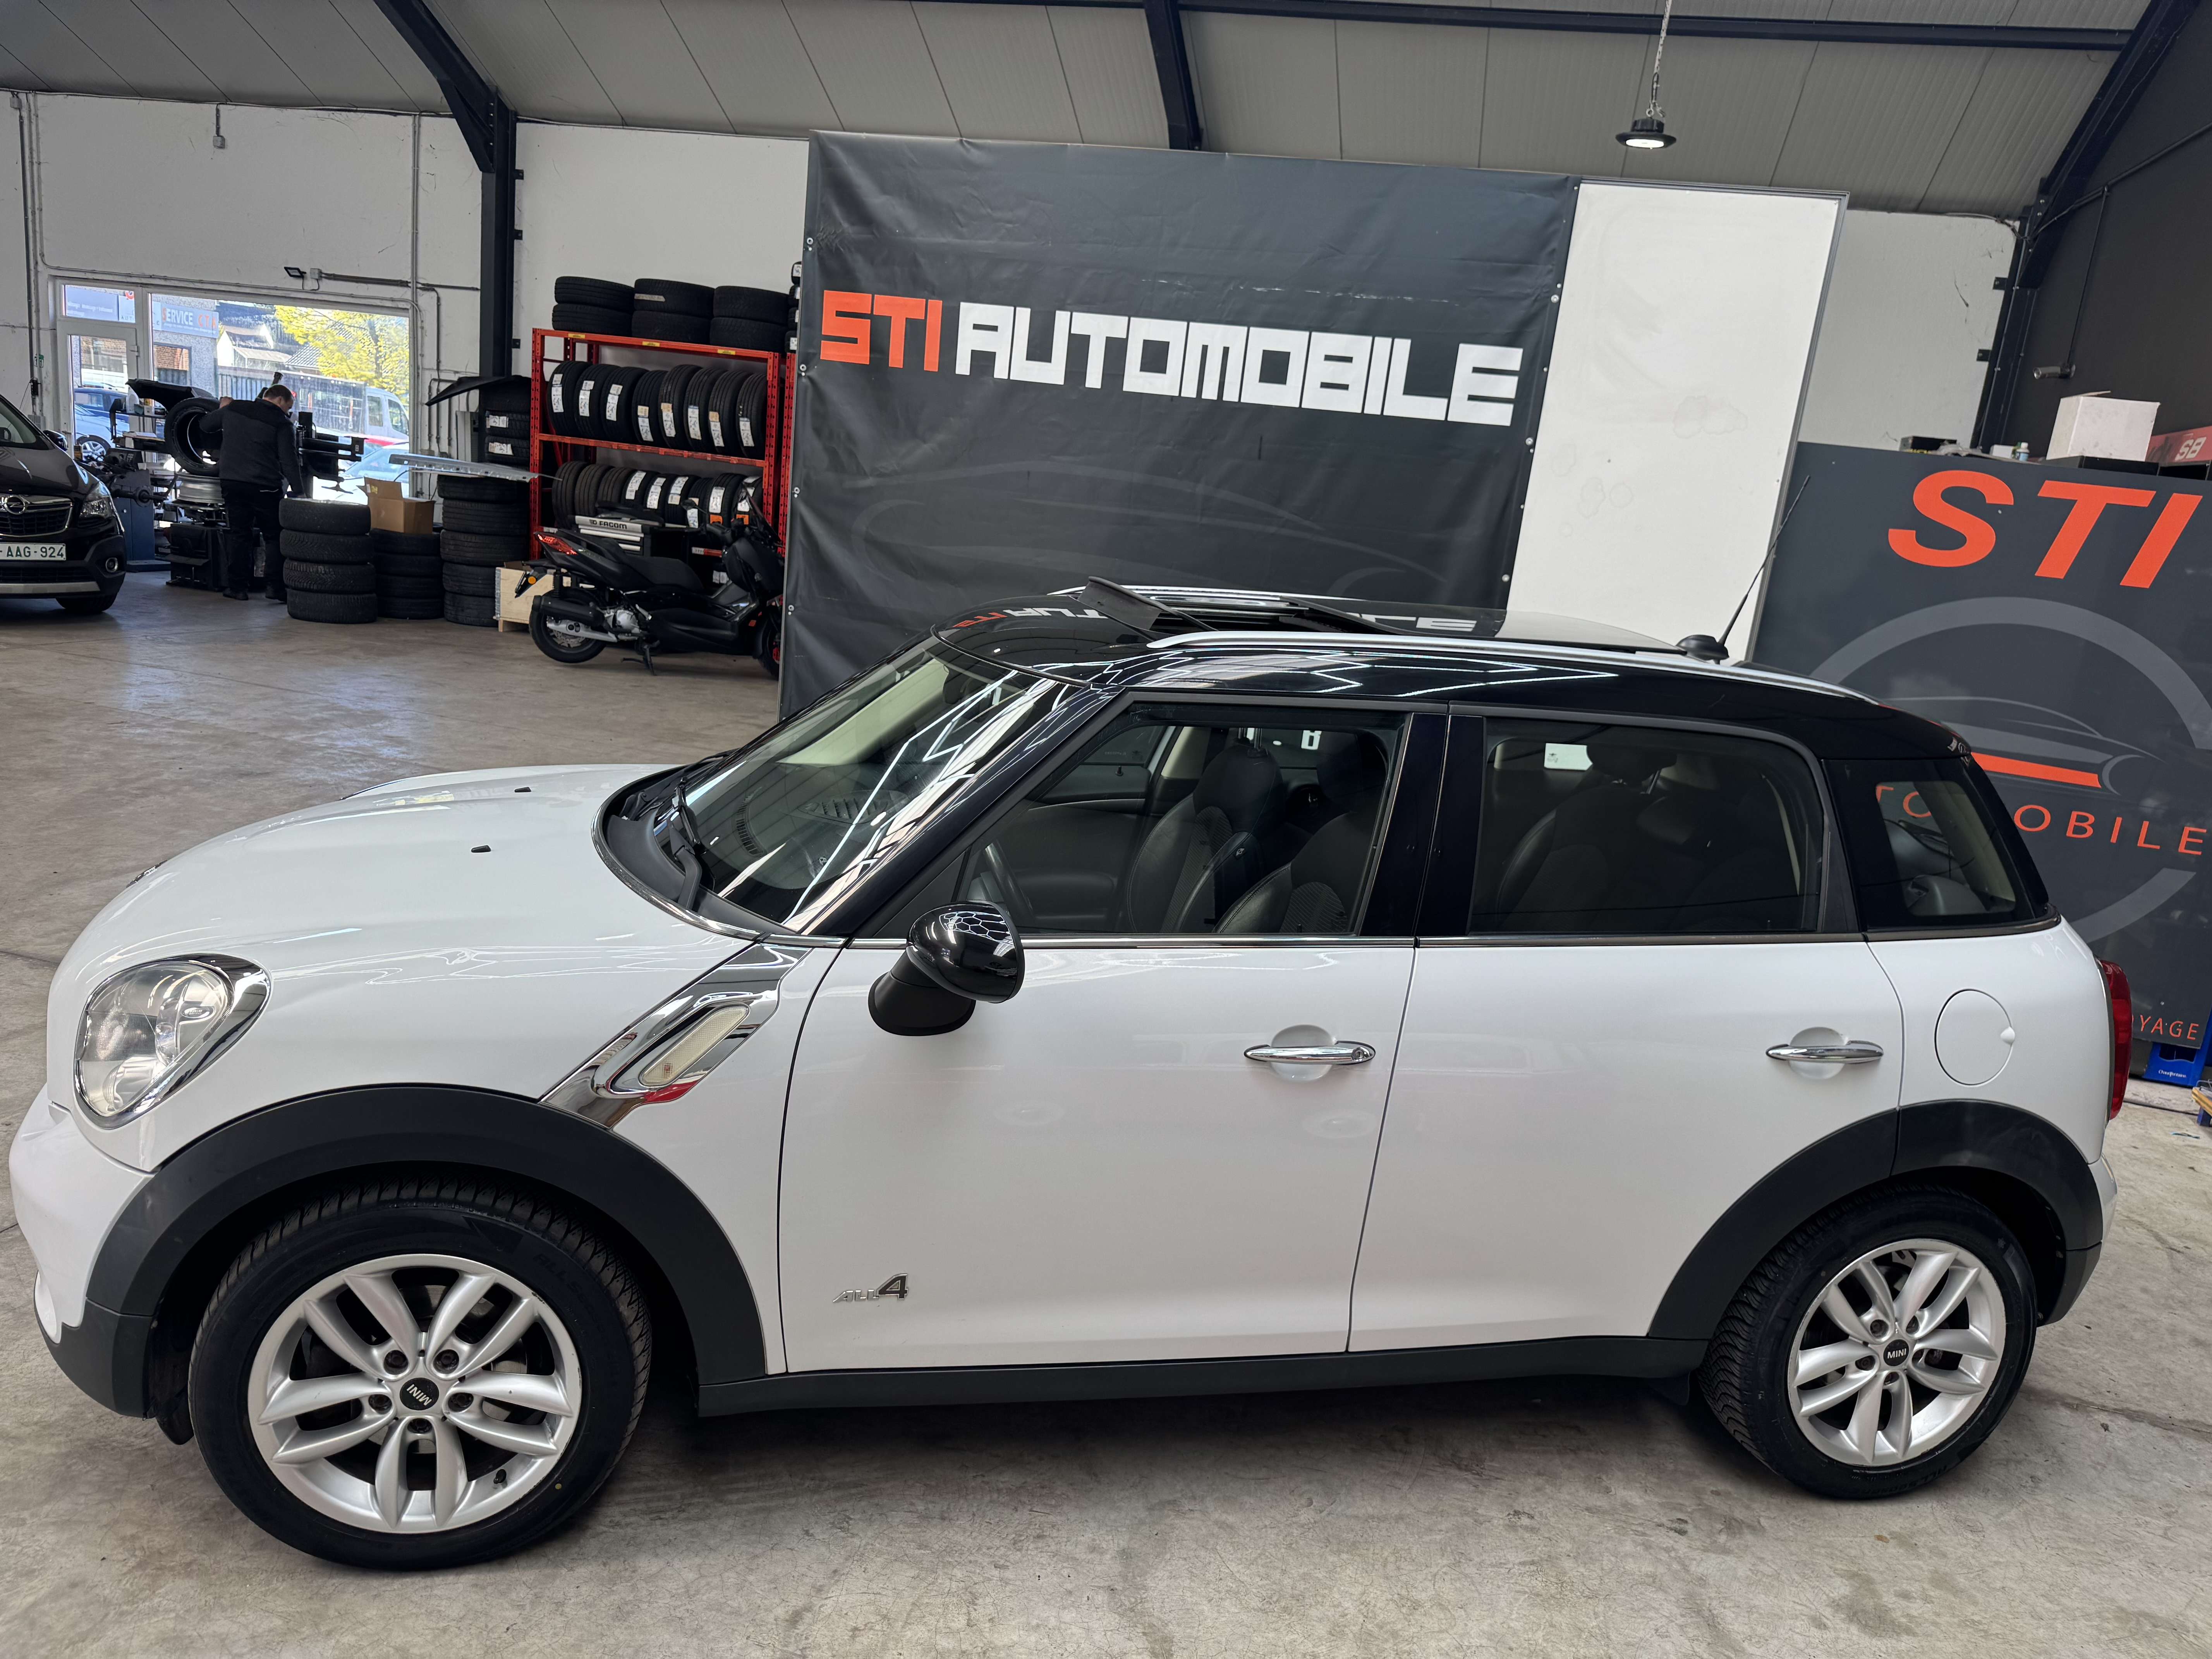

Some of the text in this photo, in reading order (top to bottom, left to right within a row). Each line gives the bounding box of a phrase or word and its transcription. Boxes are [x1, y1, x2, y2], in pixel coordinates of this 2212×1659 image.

[821, 290, 1523, 426] STI AUTOMOBILE
[1888, 471, 2202, 588] STI
[2132, 1014, 2199, 1040] YAGE
[1887, 1348, 1906, 1359] MINI
[406, 1384, 432, 1406] MINI
